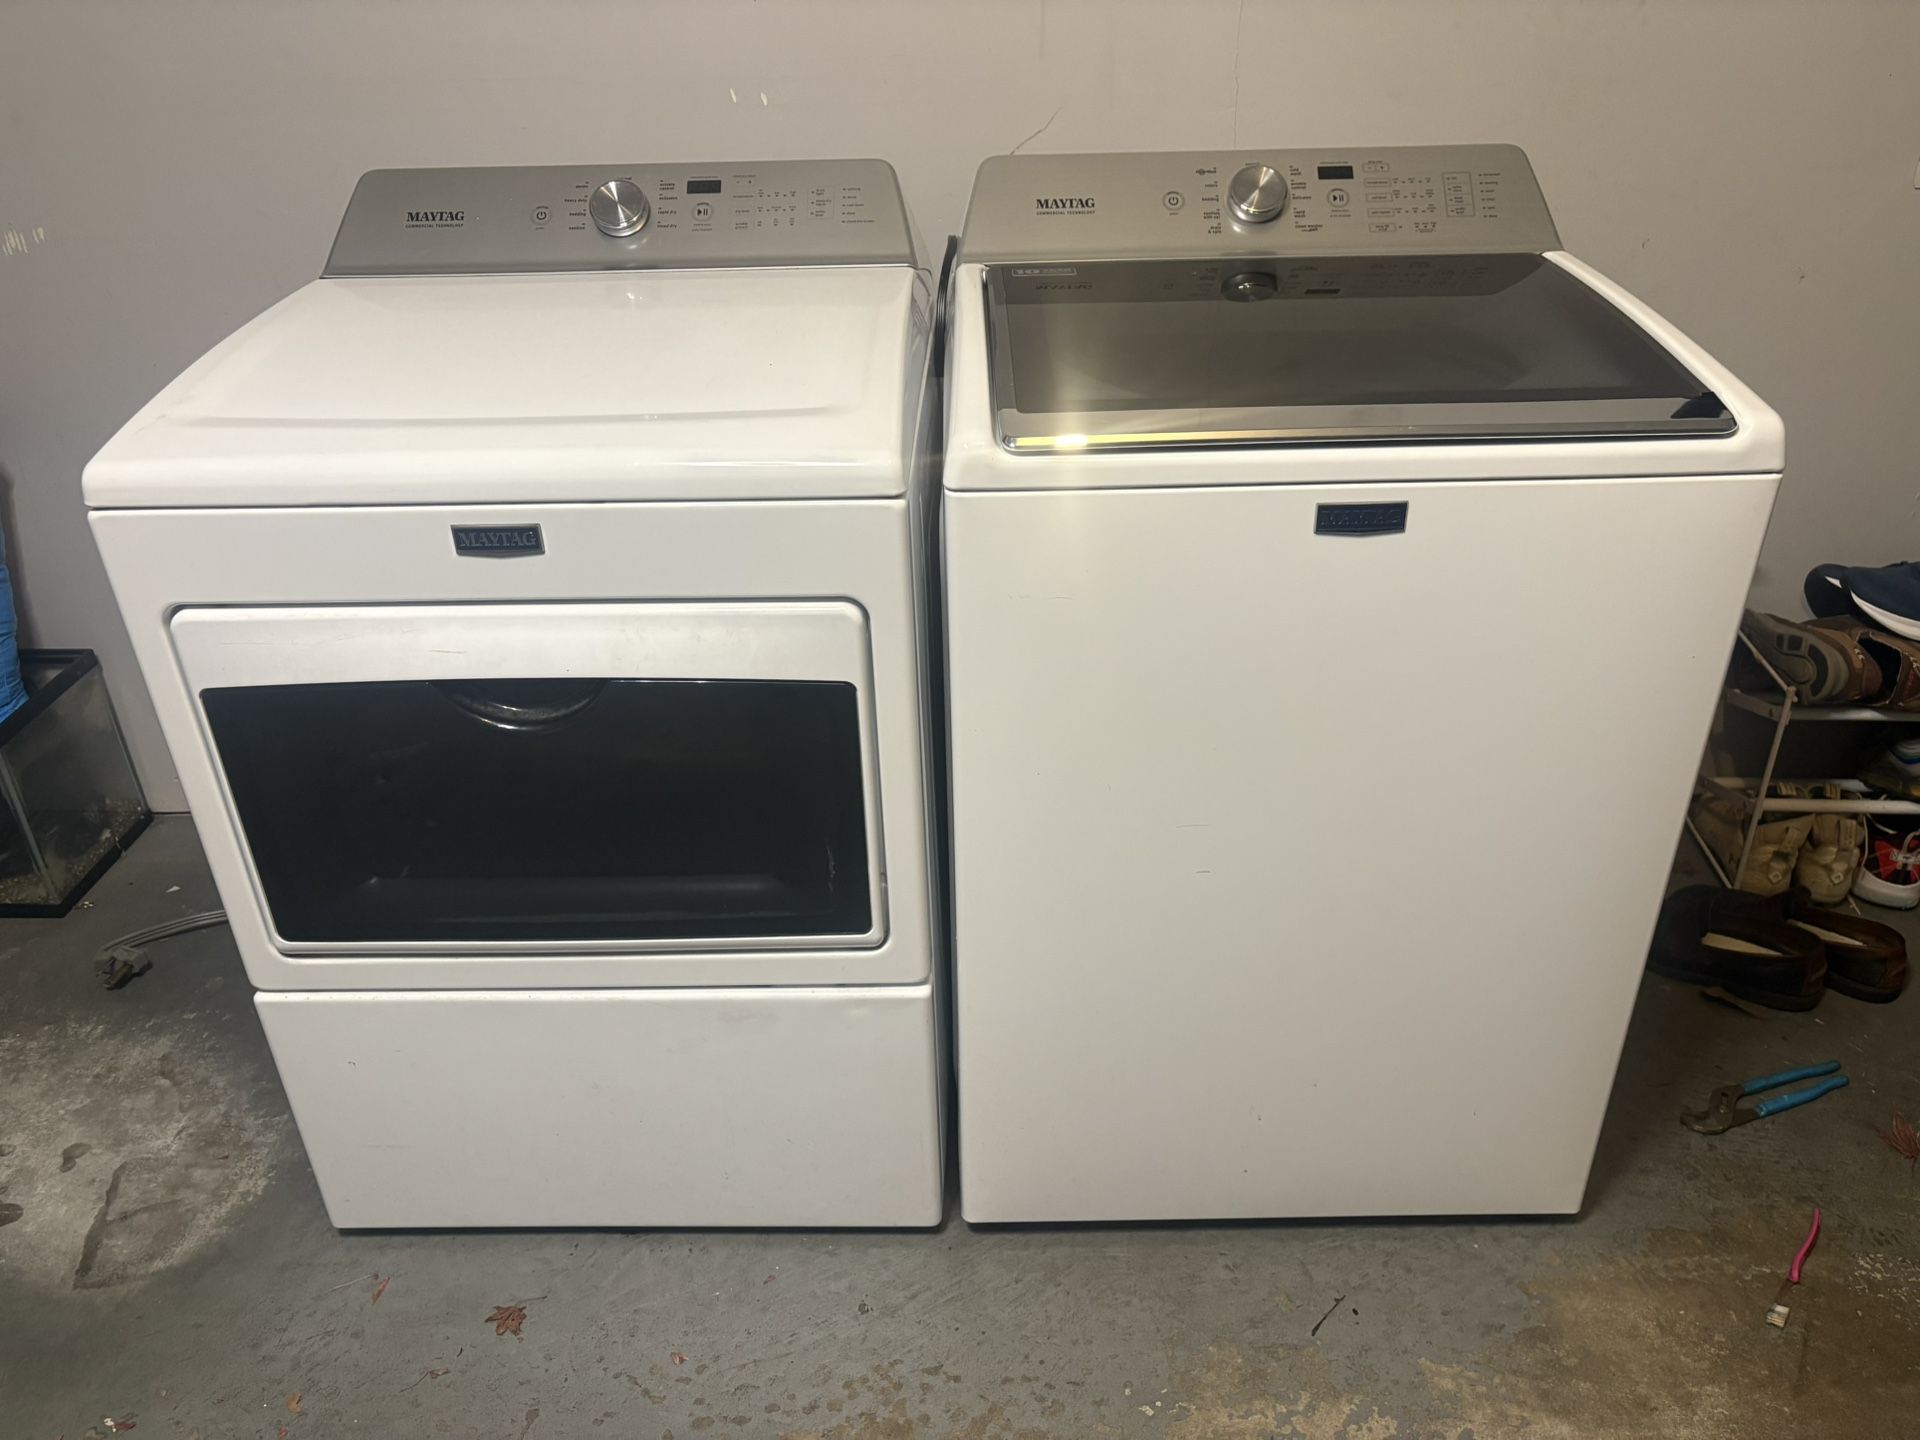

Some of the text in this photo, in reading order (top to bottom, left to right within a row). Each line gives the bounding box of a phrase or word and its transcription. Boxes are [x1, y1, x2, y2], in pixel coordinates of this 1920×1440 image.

[1036, 197, 1095, 209] MAYTAG
[406, 210, 465, 222] MAYTAG
[457, 531, 537, 547] MAYTAG
